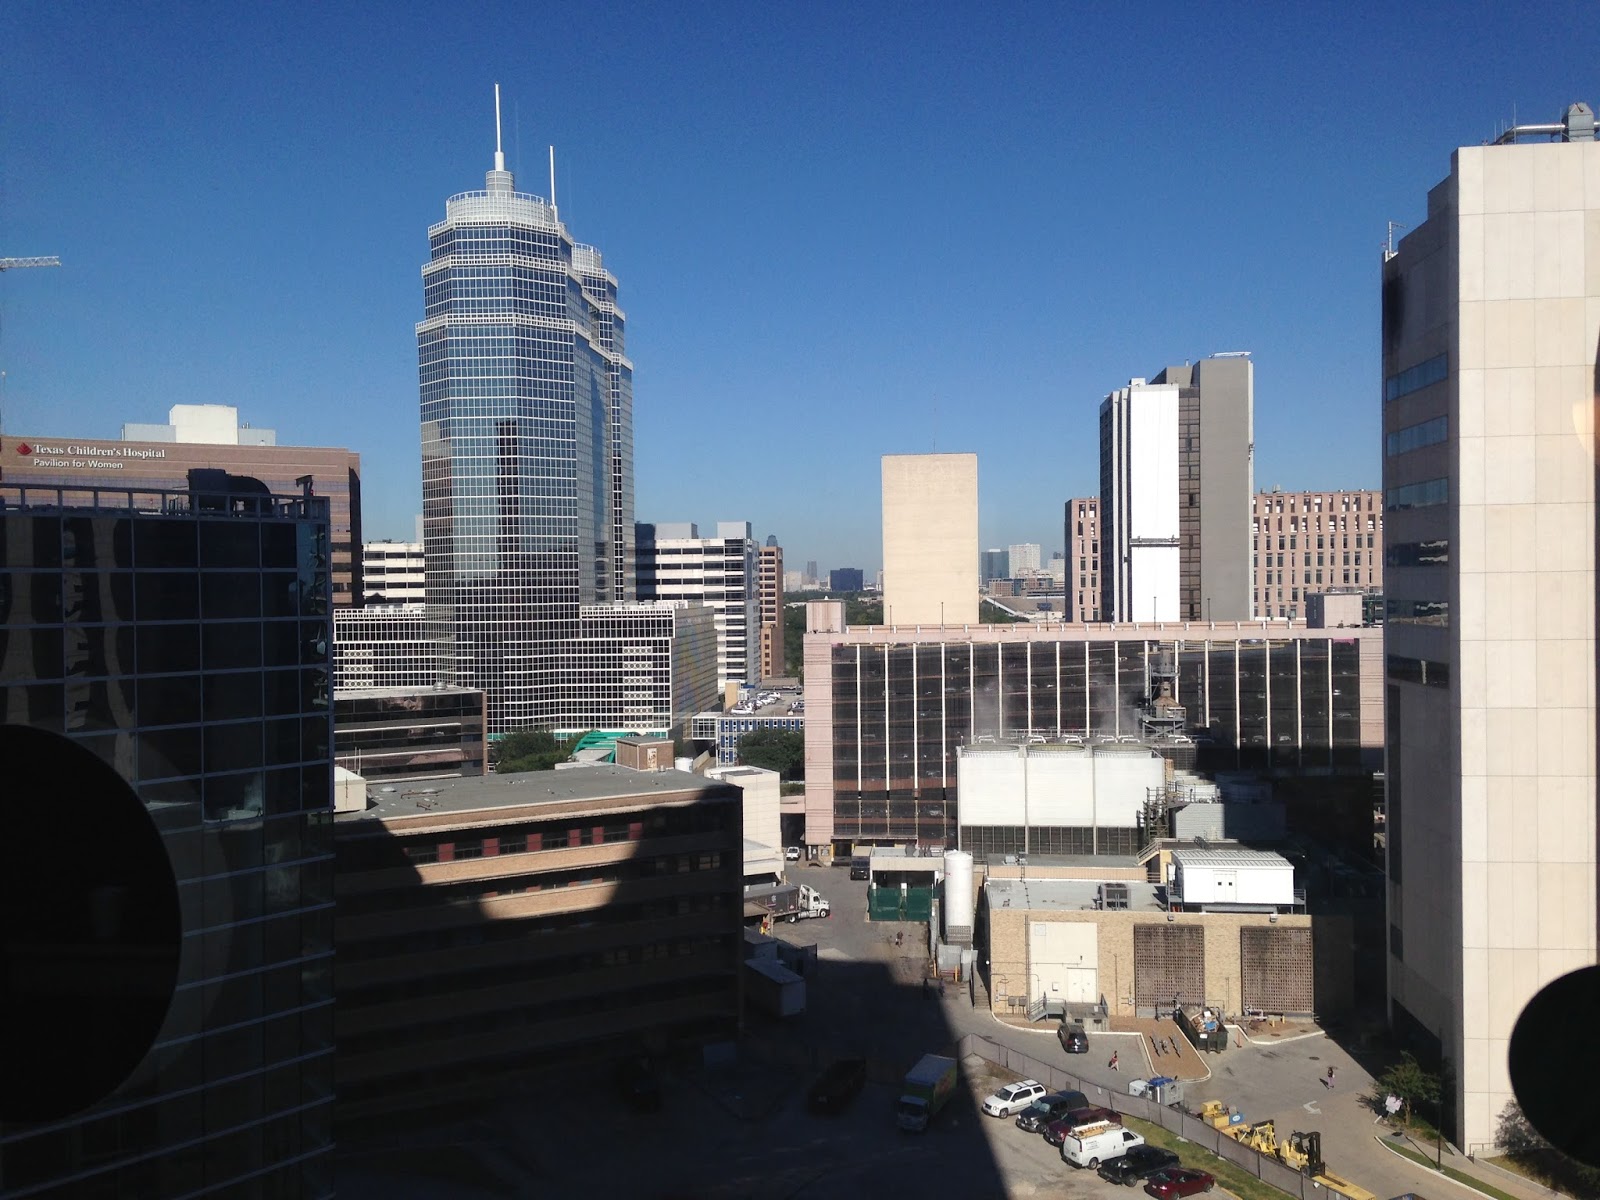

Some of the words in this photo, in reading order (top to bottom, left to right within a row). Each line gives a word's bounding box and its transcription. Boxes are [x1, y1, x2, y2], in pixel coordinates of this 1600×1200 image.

[33, 444, 64, 454] Texas
[67, 445, 121, 456] Children's
[123, 447, 165, 459] Hospital
[33, 458, 70, 467] Pavilion
[72, 459, 85, 467] for
[88, 459, 123, 469] Women
